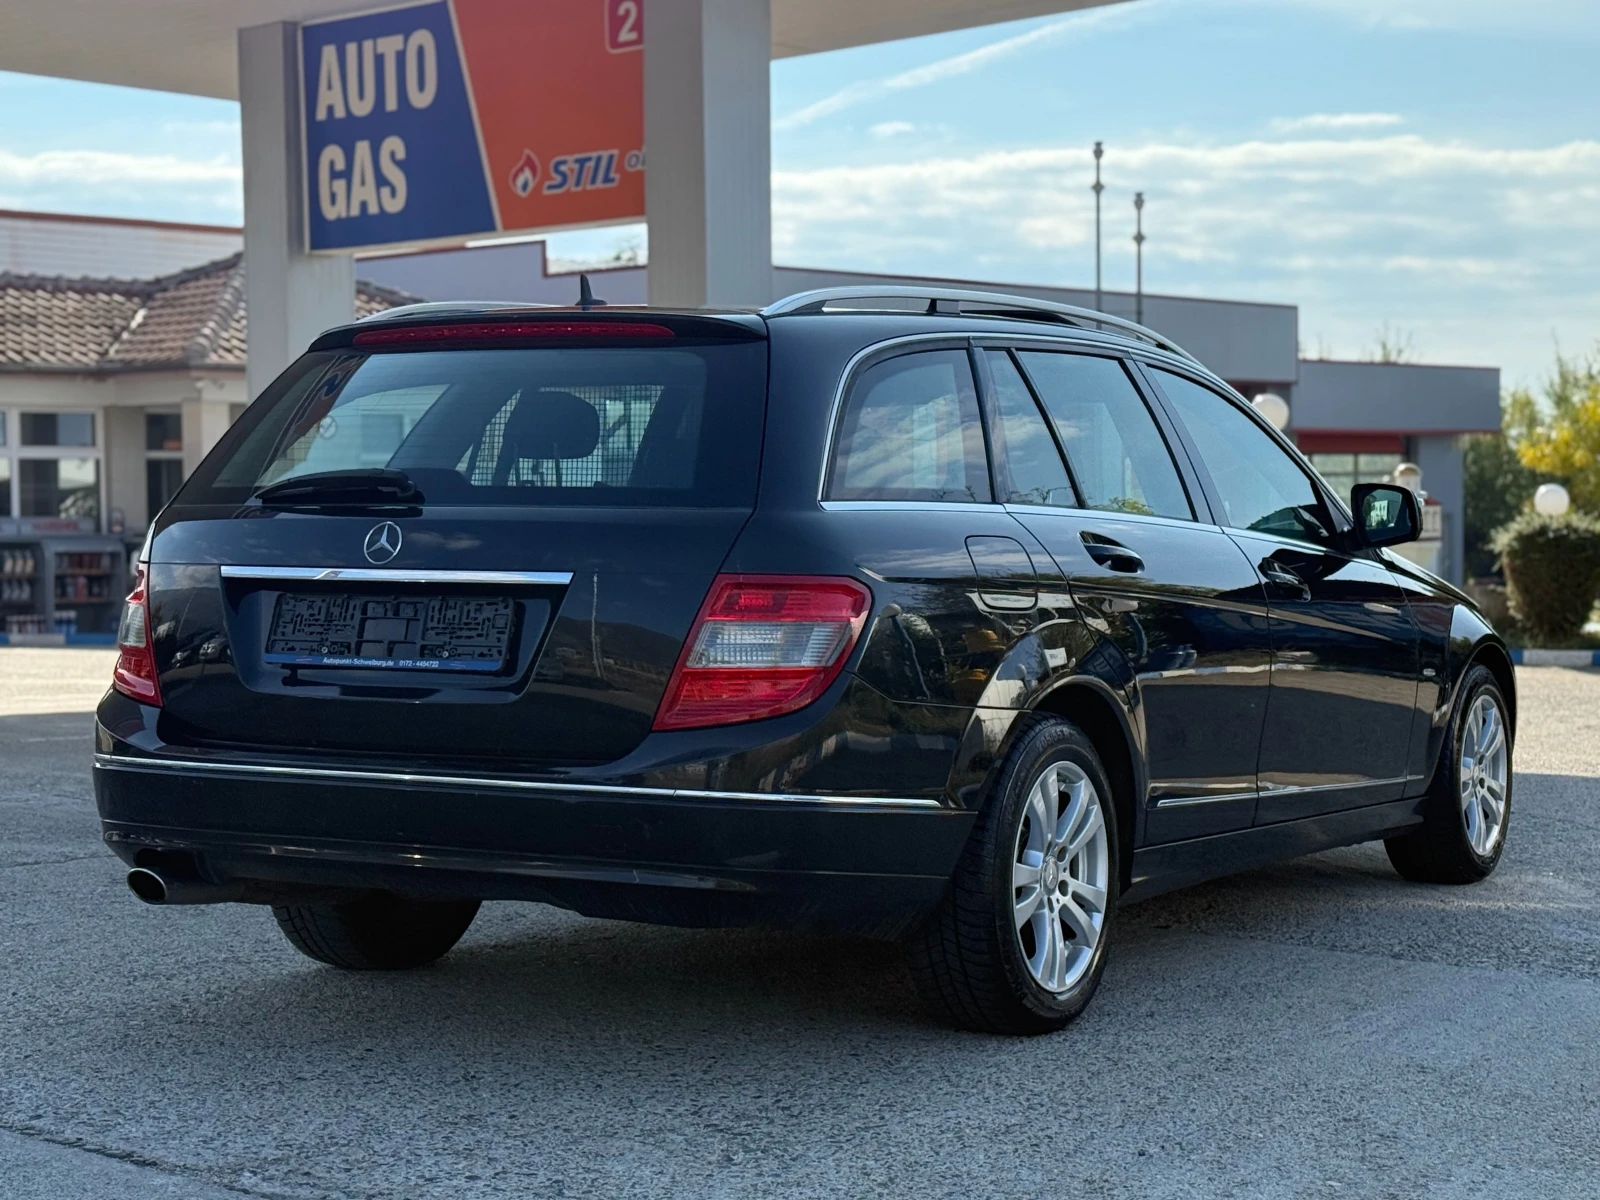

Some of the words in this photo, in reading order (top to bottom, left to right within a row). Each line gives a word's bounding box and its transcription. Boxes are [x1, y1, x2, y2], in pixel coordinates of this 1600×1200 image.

[617, 1, 638, 42] 2
[315, 28, 438, 121] AUTO
[318, 135, 407, 221] GAS
[543, 150, 618, 194] STIL
